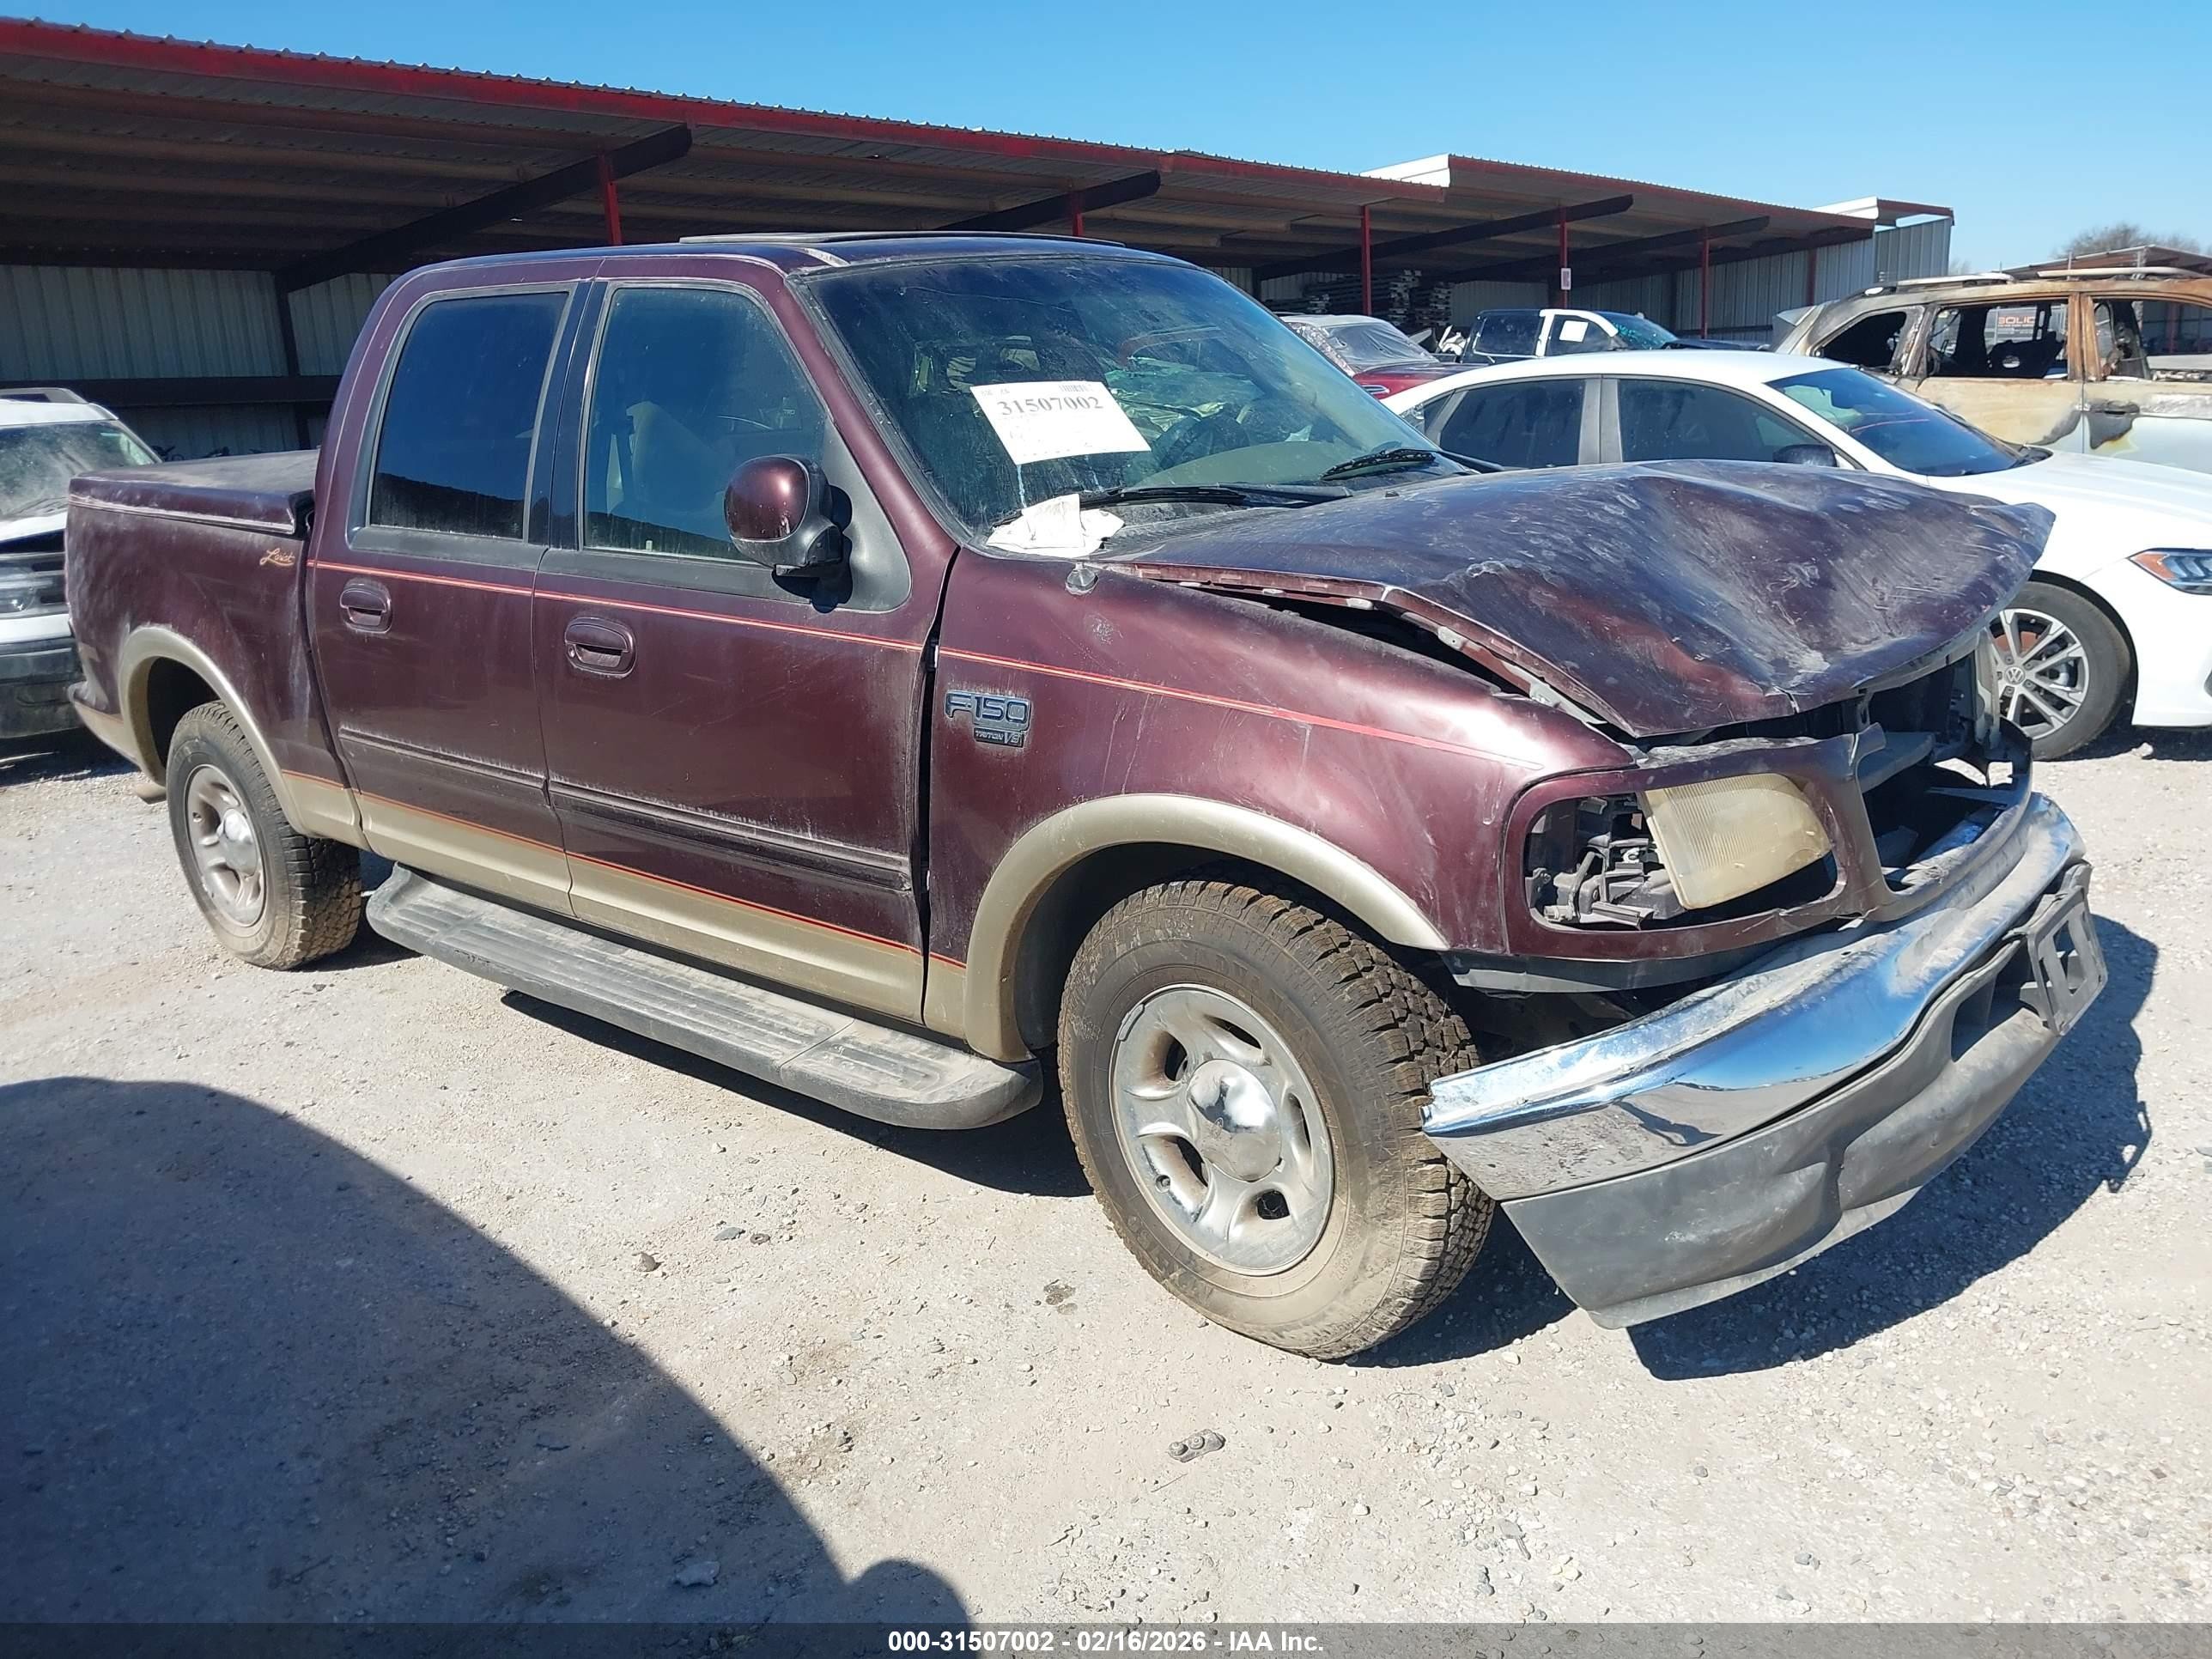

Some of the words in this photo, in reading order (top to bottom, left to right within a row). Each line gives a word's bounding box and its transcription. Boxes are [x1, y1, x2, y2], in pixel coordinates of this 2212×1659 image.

[997, 397, 1104, 416] 31507002
[975, 730, 1004, 740] TRITON
[1004, 732, 1021, 744] V8
